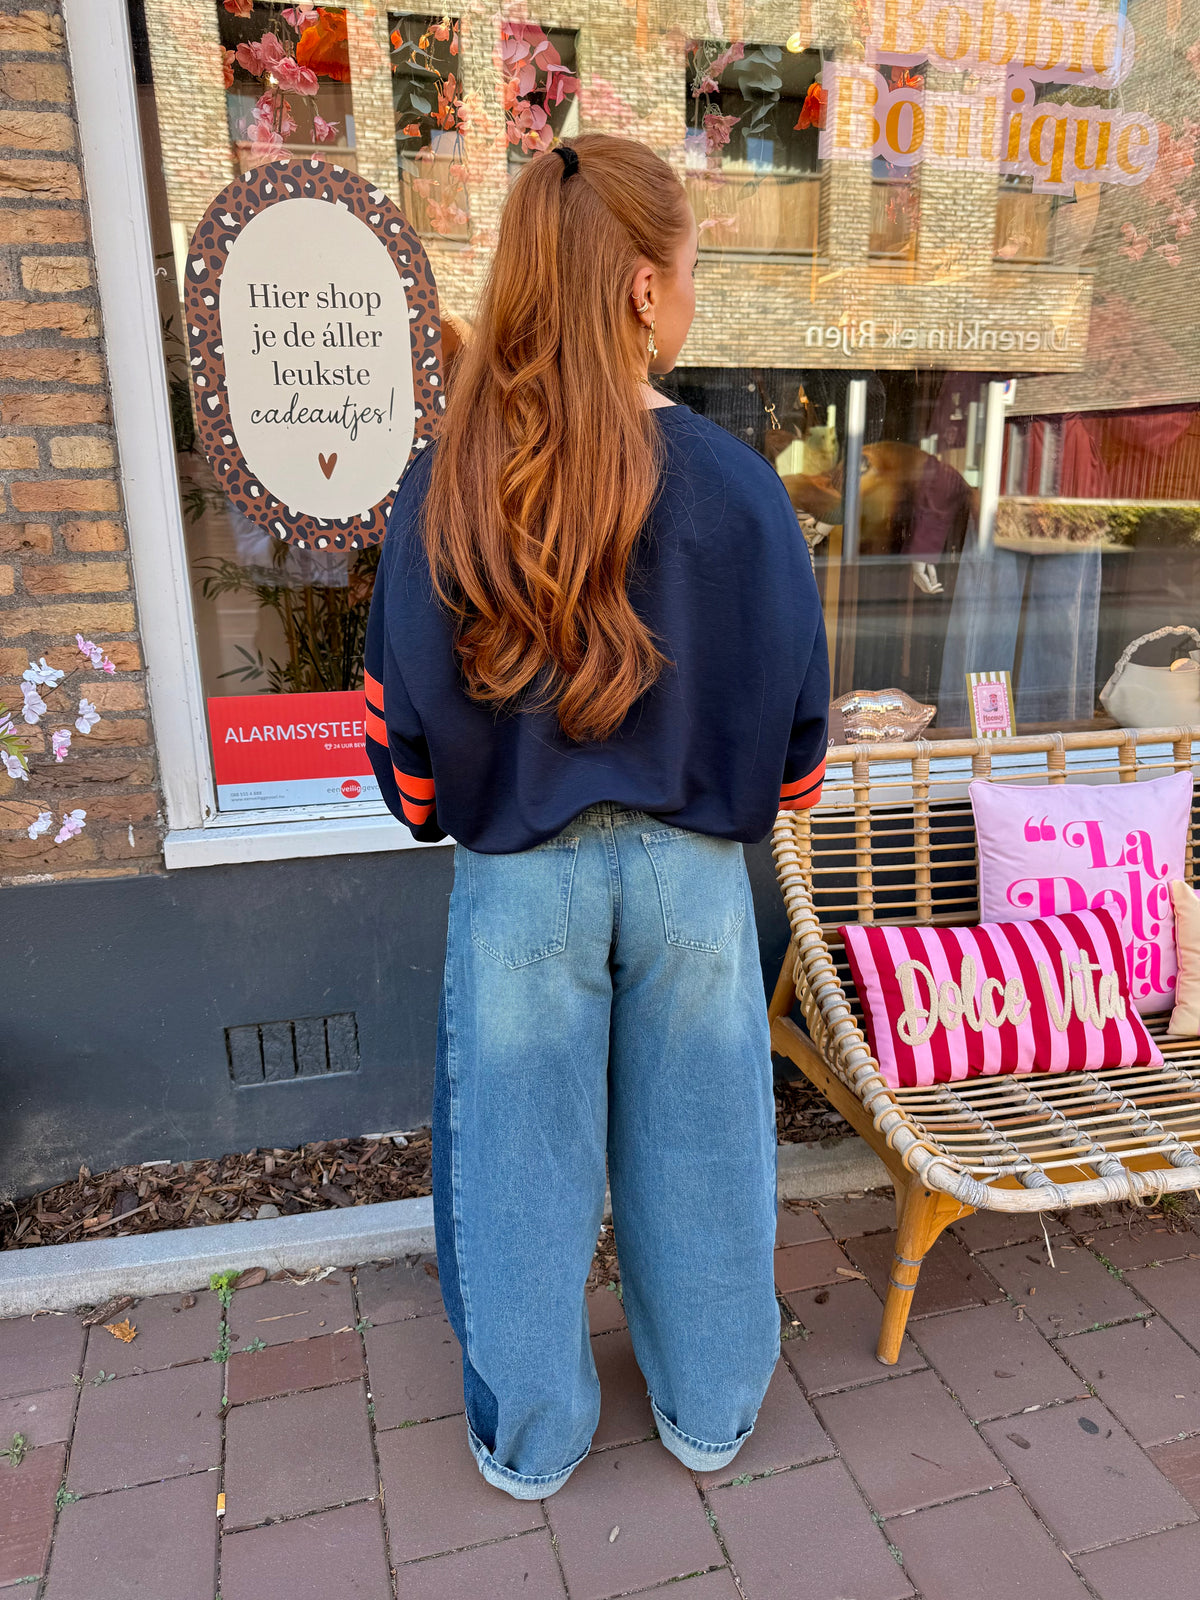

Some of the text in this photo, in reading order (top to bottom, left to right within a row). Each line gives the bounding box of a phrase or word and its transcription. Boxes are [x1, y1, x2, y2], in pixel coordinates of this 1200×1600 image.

[833, 75, 1150, 184] Boutique
[248, 283, 381, 317] Hier shop
[251, 322, 383, 355] je de áller
[271, 360, 371, 386] leukste
[250, 387, 395, 442] cadeautjes!
[224, 720, 366, 744] ALARMSYSTEE
[1006, 870, 1174, 941] Dolc
[895, 949, 1126, 1046] Dolce Vita
